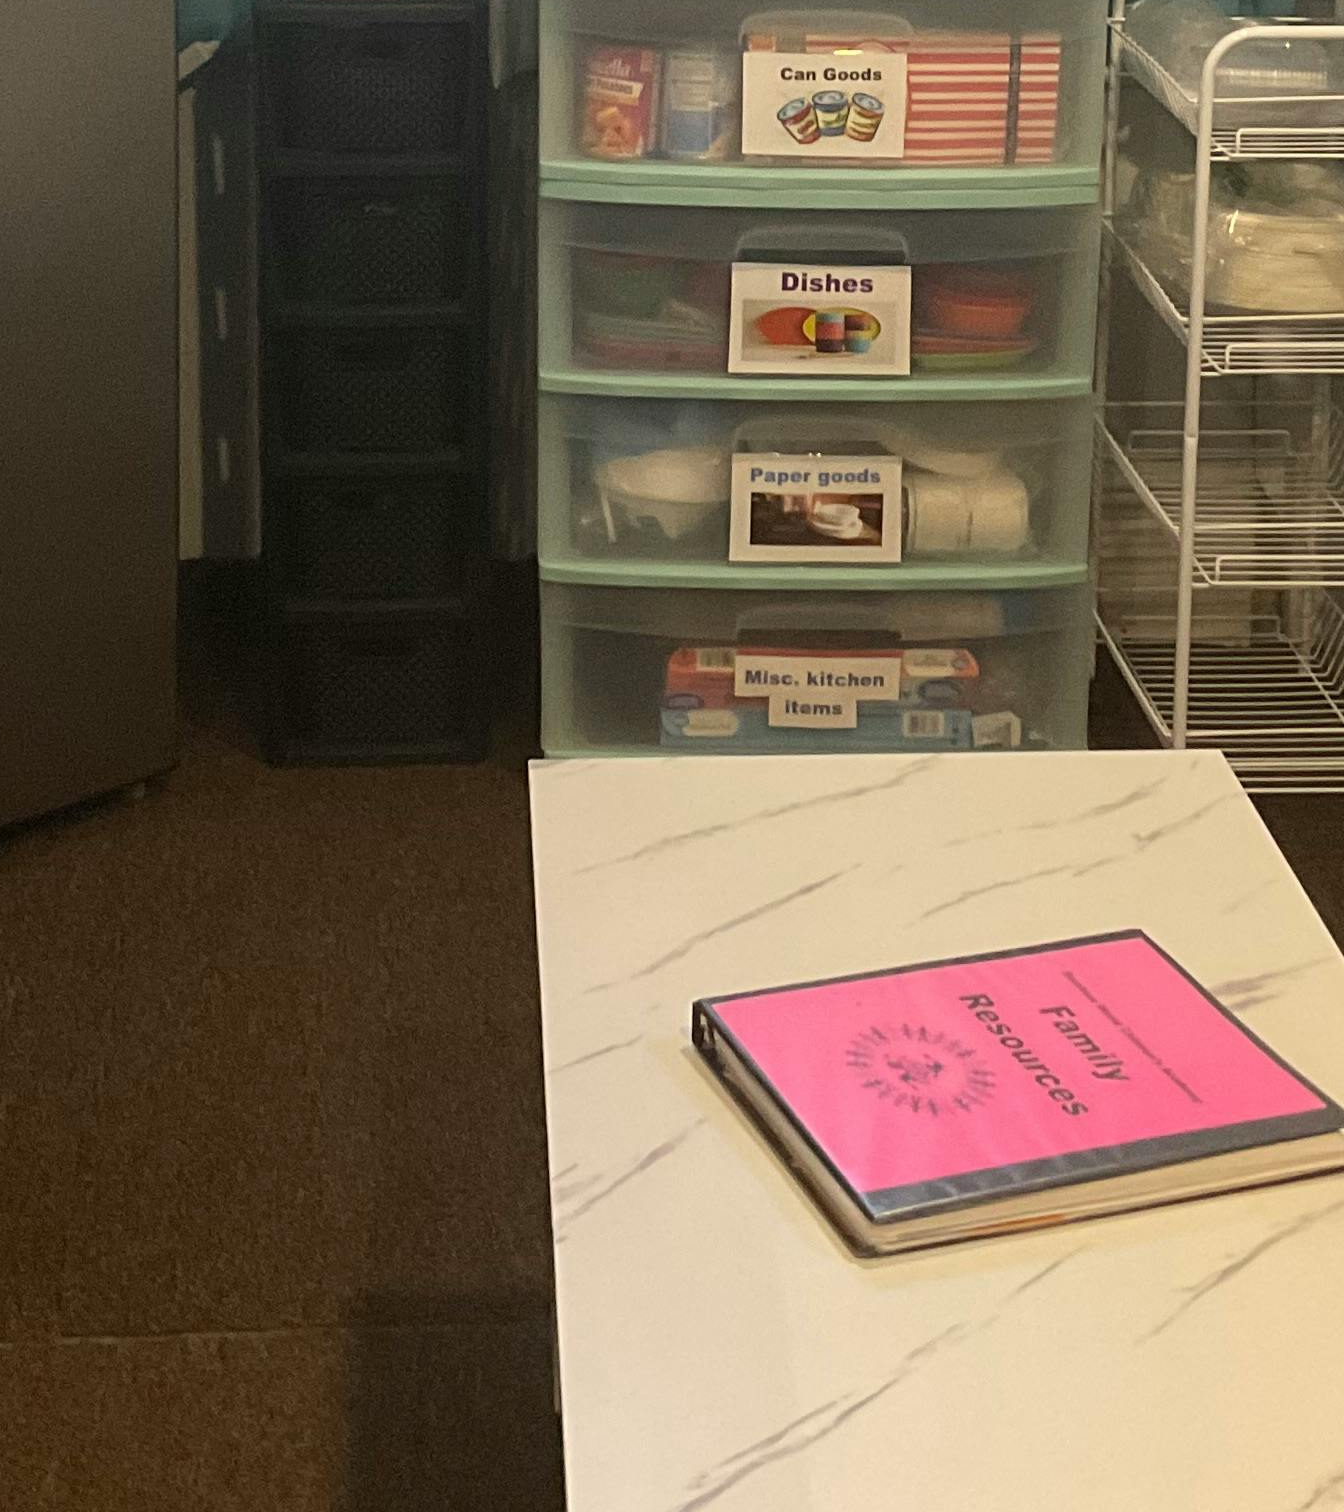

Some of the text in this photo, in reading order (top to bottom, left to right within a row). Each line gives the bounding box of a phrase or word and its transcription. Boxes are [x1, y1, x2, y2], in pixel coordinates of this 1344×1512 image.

[780, 67, 882, 82] Can Goods
[782, 272, 873, 293] Dishes
[750, 468, 881, 487] Paper goods
[745, 670, 885, 687] Misc. kitchen
[785, 700, 843, 715] items
[1039, 1005, 1130, 1081] Family
[959, 993, 1089, 1116] Resources
